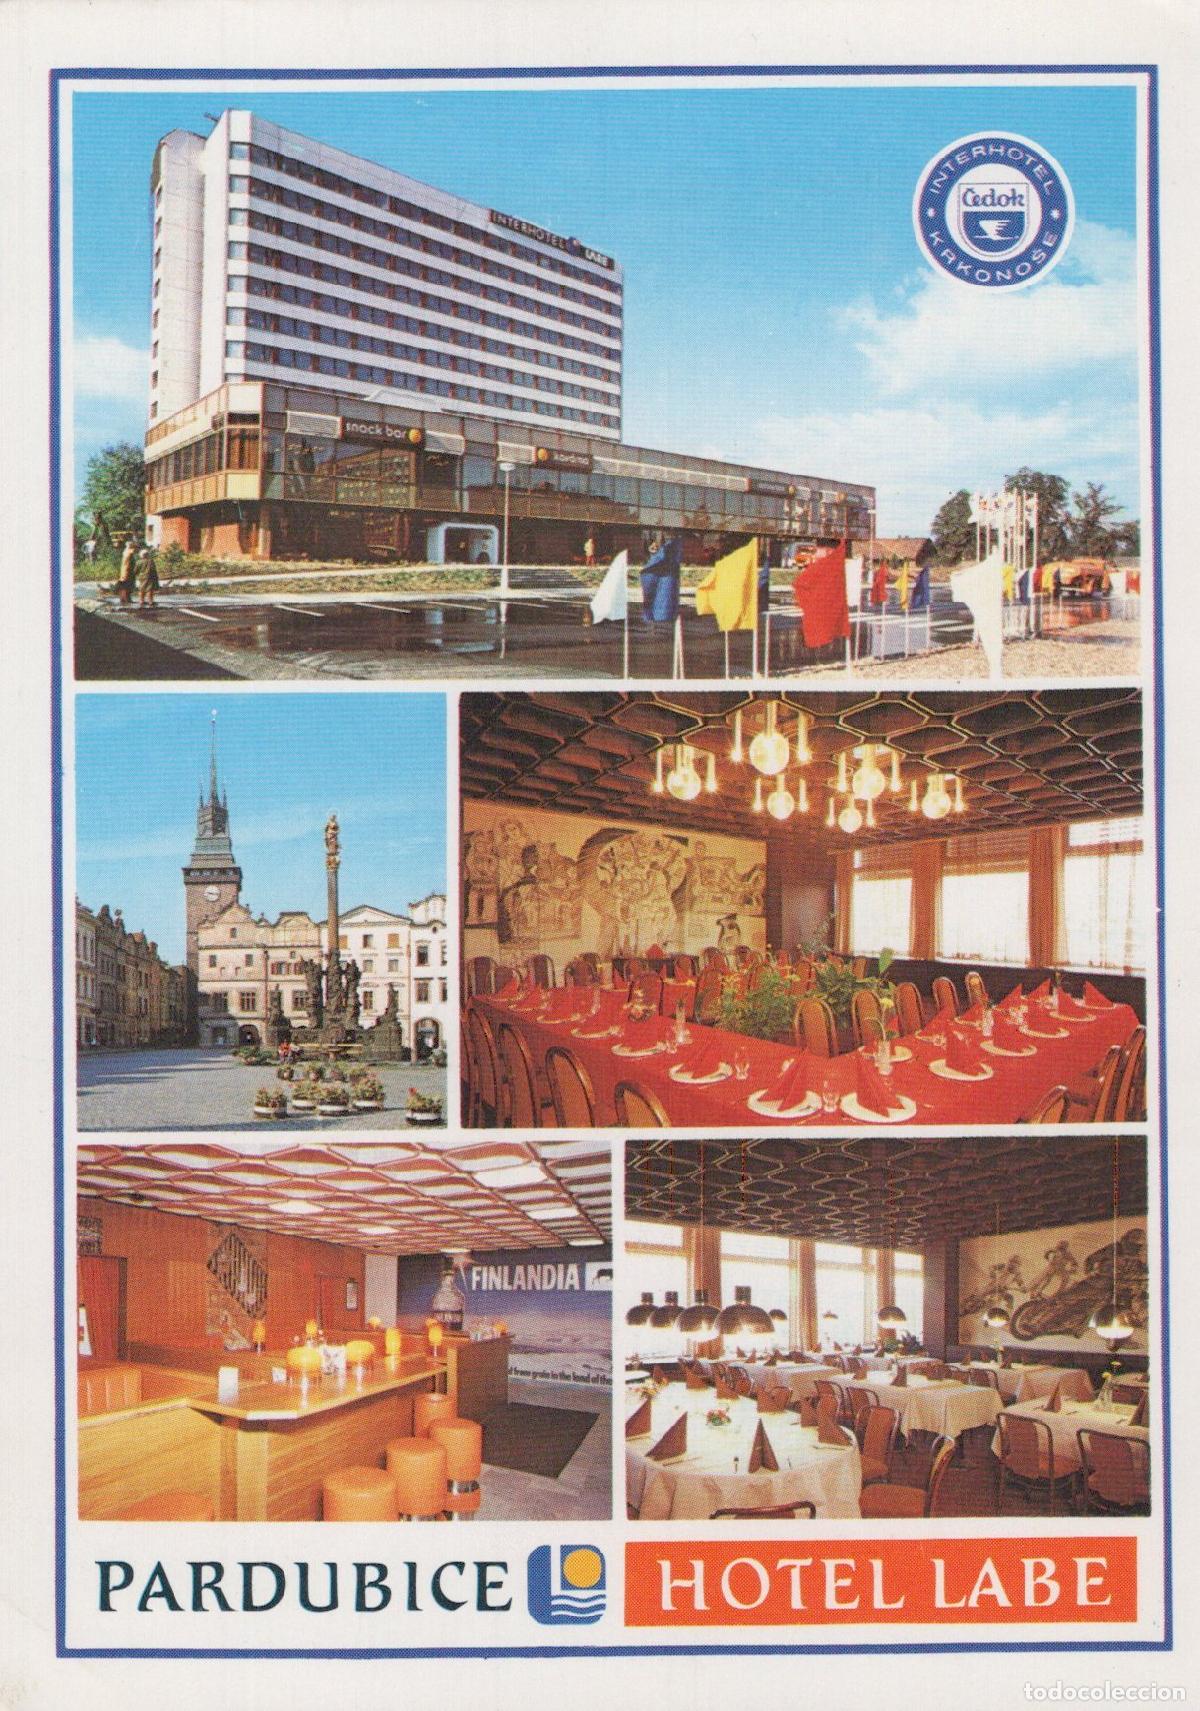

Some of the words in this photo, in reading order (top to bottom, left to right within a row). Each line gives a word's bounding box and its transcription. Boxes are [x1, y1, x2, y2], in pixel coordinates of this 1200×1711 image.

[930, 143, 1056, 196] INTERHOTEL
[493, 212, 567, 250] INTERHOTEL
[346, 422, 383, 435] snack
[385, 424, 406, 439] bar
[471, 1263, 580, 1291] FINLANDIA
[95, 1560, 513, 1613] PARDUBICE
[657, 1557, 905, 1611] HOTEL
[932, 1556, 1112, 1609] LABE
